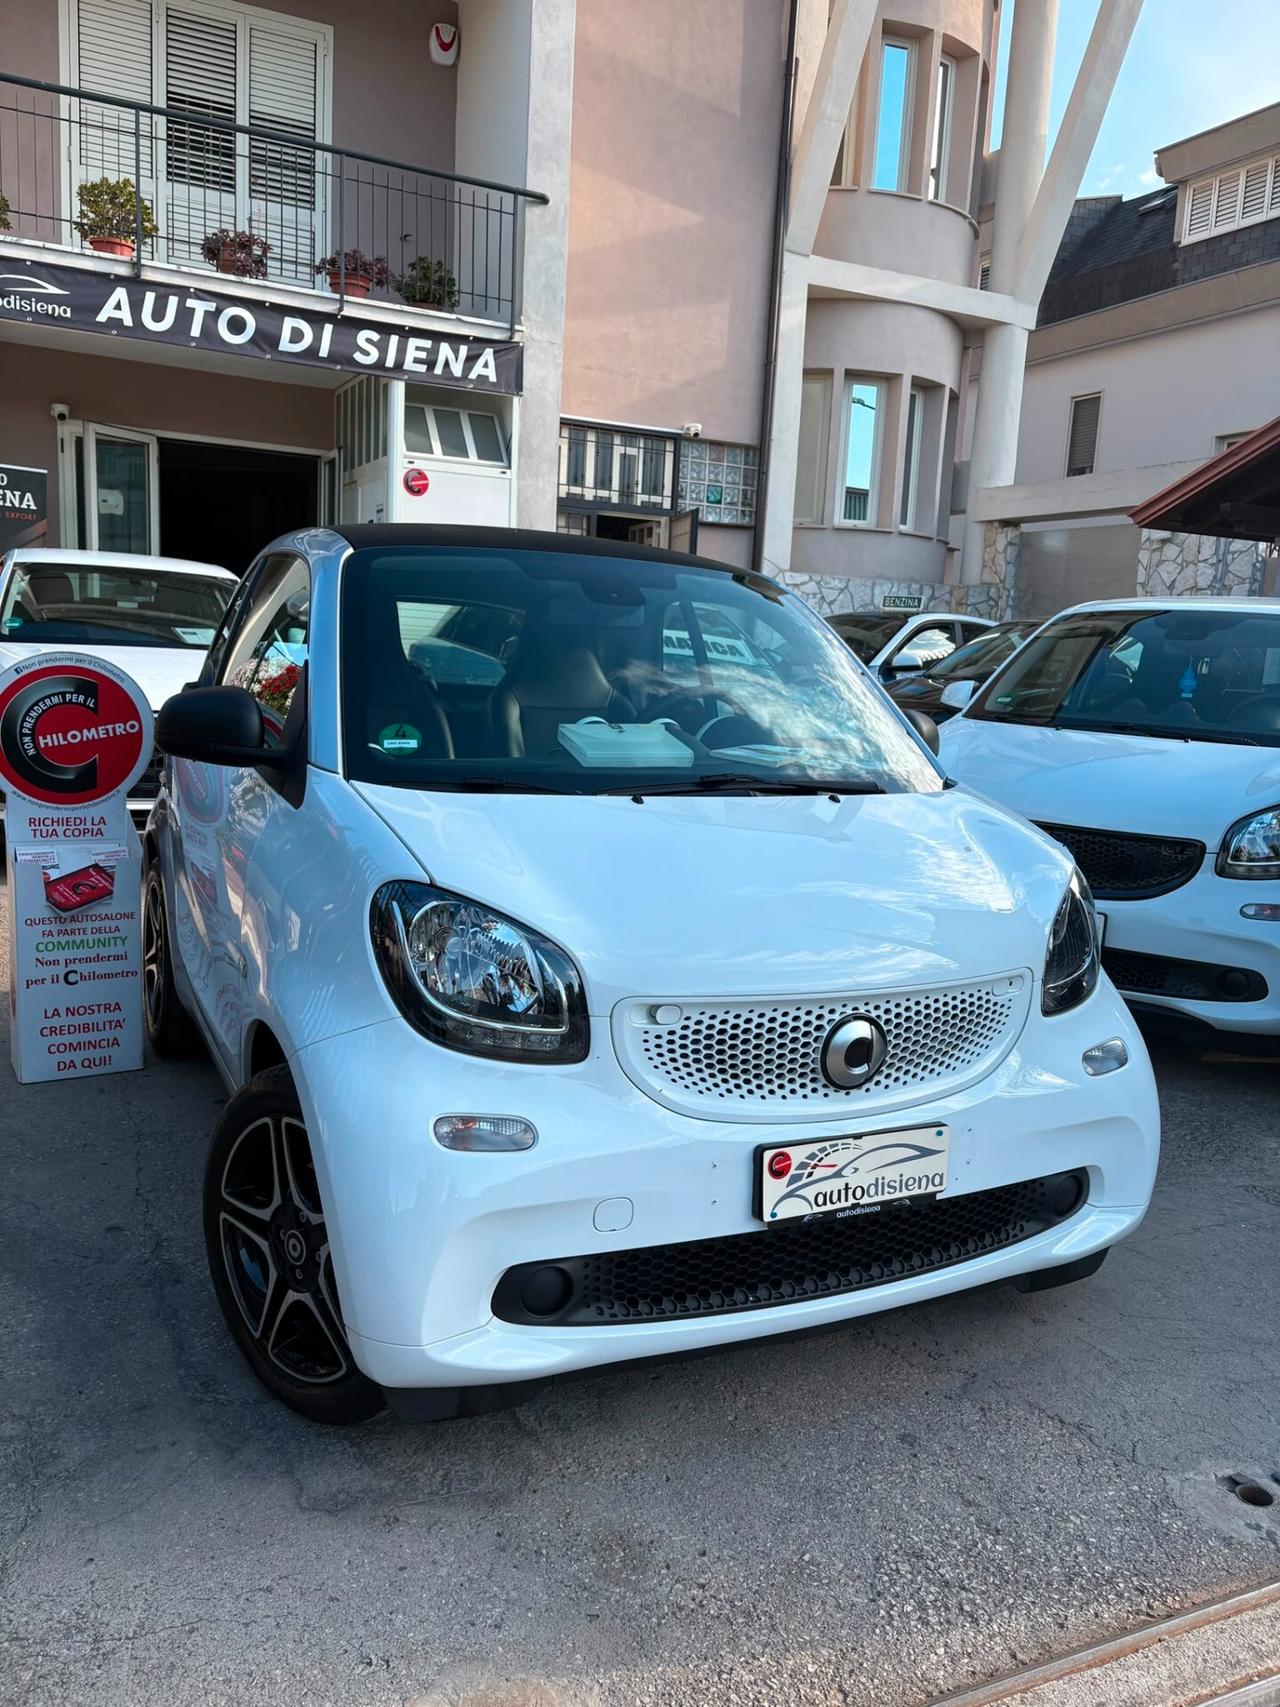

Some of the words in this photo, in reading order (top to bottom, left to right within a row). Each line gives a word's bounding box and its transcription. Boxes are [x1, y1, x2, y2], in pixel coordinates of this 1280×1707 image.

[0, 295, 71, 318] disiena
[95, 286, 257, 345] AUTO
[278, 316, 334, 358] DI
[352, 328, 498, 383] SIENA
[5, 511, 37, 520] EXPORT
[884, 596, 920, 607] BENZINA
[22, 661, 37, 671] Non
[38, 657, 74, 667] prendermi
[74, 657, 87, 665] per
[93, 660, 126, 683] Chilometro
[65, 693, 85, 704] PER
[86, 697, 95, 708] IL
[22, 694, 63, 734] PRENDERMI
[395, 724, 408, 739] 4
[22, 735, 37, 757] NON
[28, 816, 87, 828] RICHIEDI
[91, 816, 107, 827] LA
[31, 828, 59, 839] TUA
[63, 827, 104, 838] COPIA
[25, 915, 68, 927] QUESTO
[69, 911, 136, 924] AUTOSALONE
[42, 929, 54, 939] FA
[57, 927, 88, 937] PARTE
[91, 925, 120, 935] DELLA
[35, 936, 128, 953] COMMUNITY
[35, 957, 60, 968] Non
[64, 951, 128, 968] prendermi
[25, 976, 47, 989] per
[51, 974, 59, 984] il
[63, 969, 138, 986] Chilometro
[44, 1008, 61, 1019] LA
[65, 1002, 122, 1018] NOSTRA
[47, 1037, 121, 1055] COMINCIA
[57, 1059, 77, 1072] DA
[81, 1054, 112, 1069] QUI!
[813, 1171, 945, 1208] autodisiena
[836, 1204, 881, 1218] autodisiena
